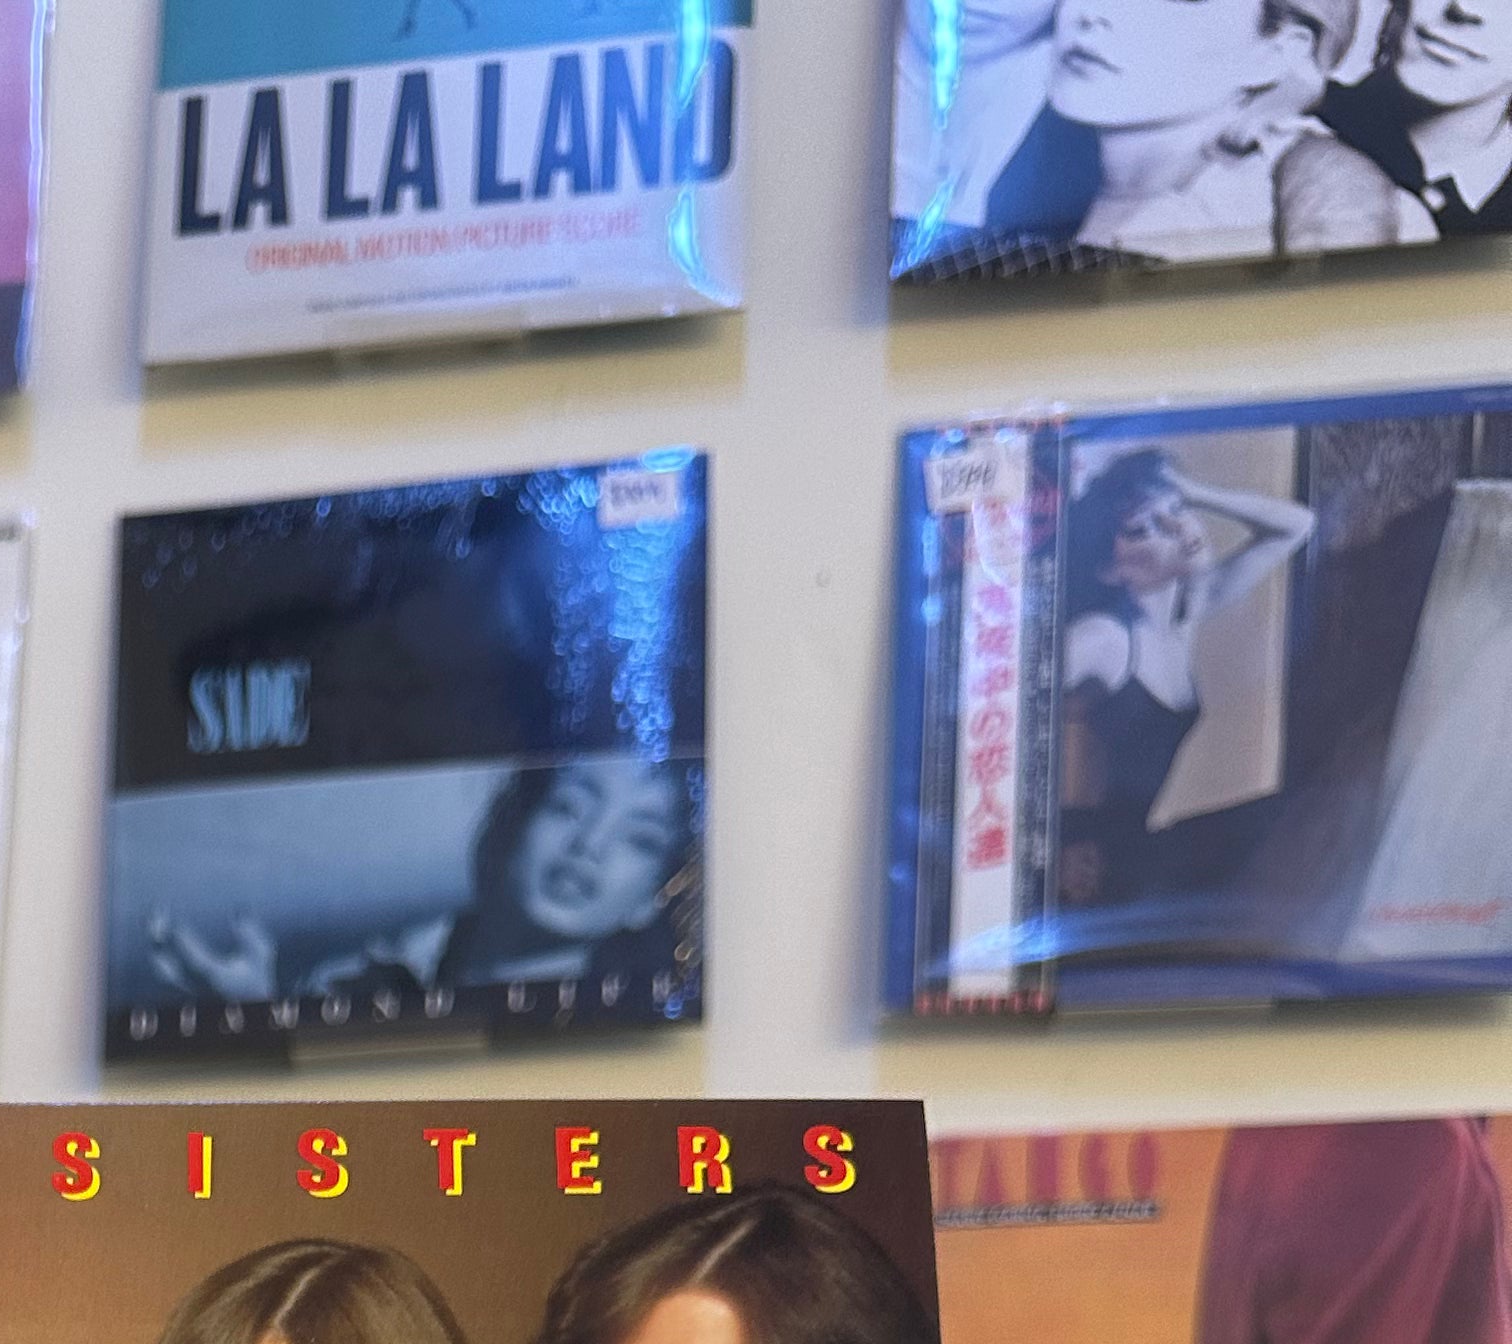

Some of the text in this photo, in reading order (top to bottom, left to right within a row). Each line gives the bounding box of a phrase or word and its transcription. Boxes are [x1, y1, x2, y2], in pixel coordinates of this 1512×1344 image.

[176, 37, 736, 237] LA LA LAND
[51, 1126, 856, 1199] SISTERS
